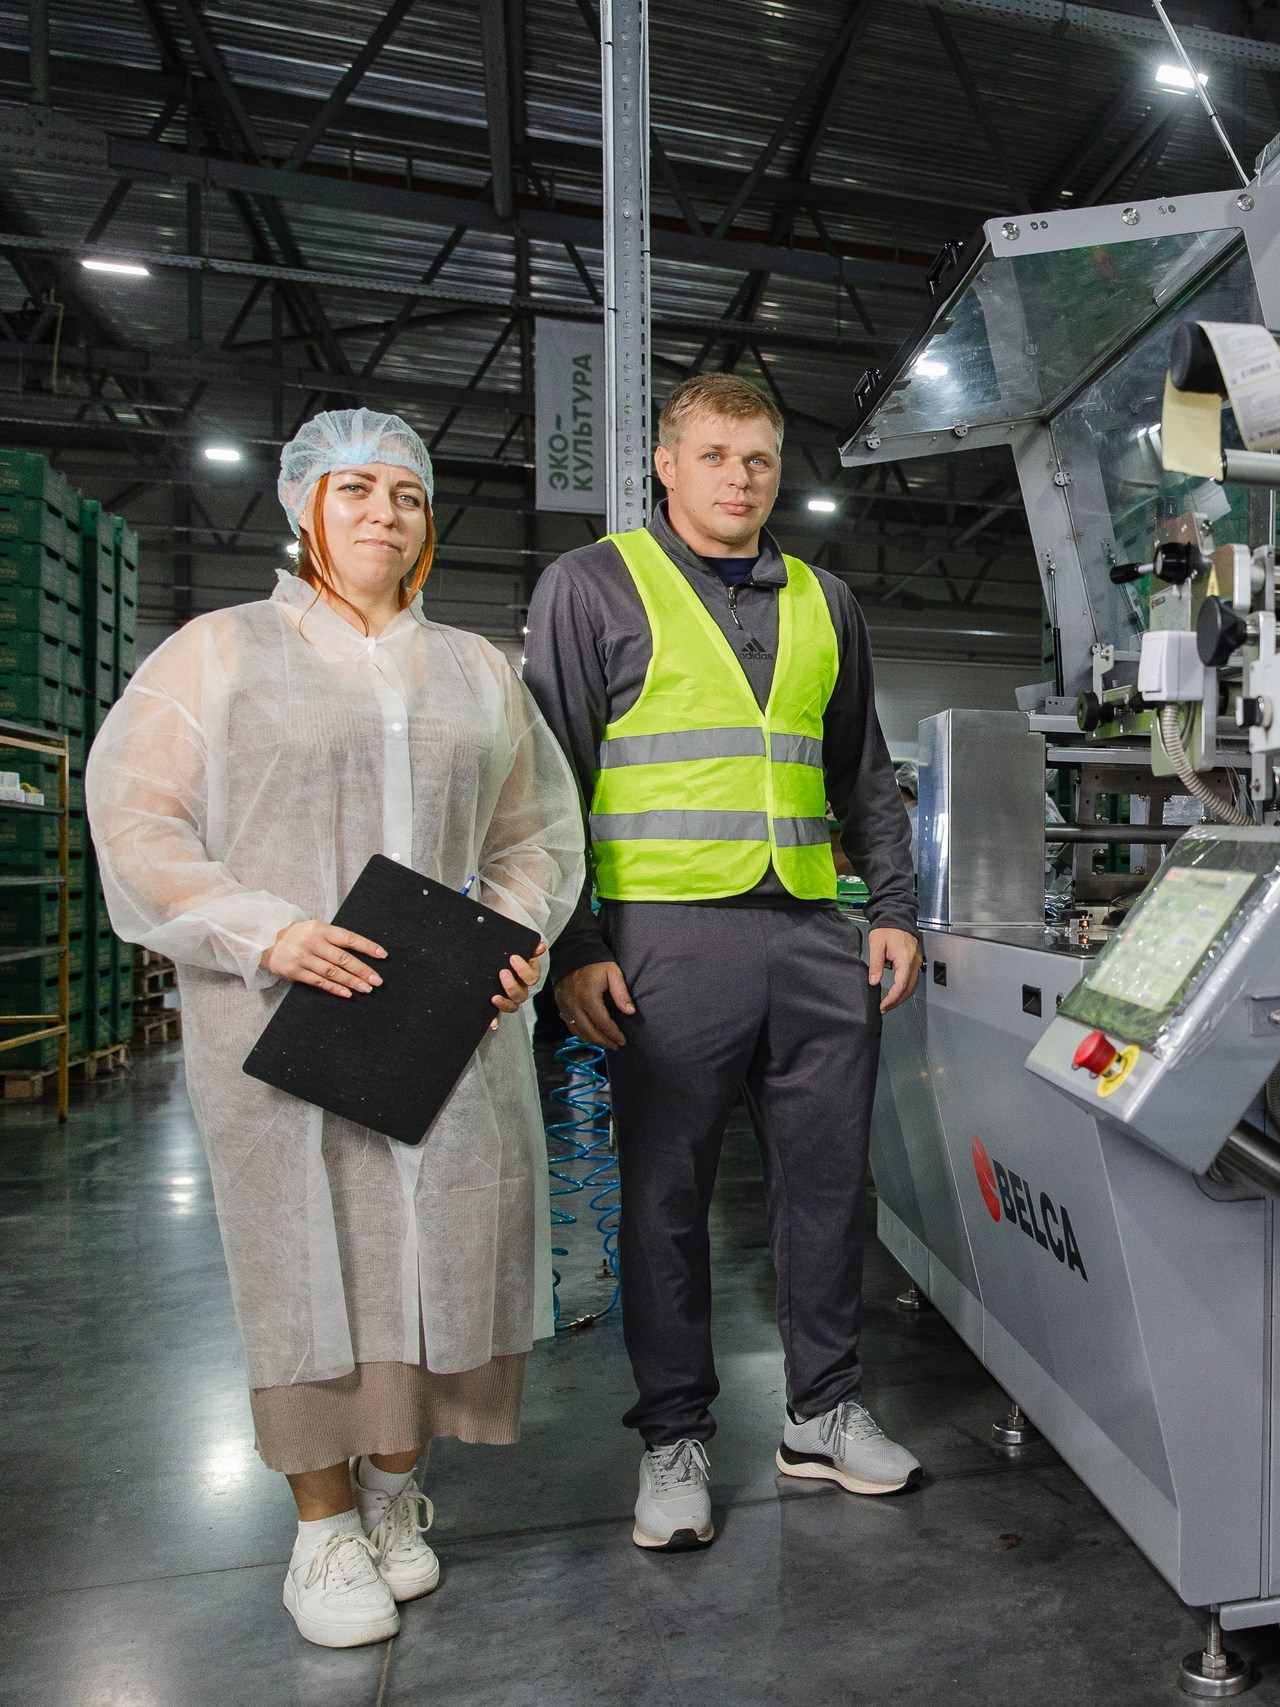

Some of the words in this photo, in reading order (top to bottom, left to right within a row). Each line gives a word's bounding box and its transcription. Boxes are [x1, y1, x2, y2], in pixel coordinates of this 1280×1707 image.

[571, 352, 593, 492] КУЛЬТУРА
[739, 650, 774, 660] adidas
[992, 1158, 1089, 1284] BELCA
